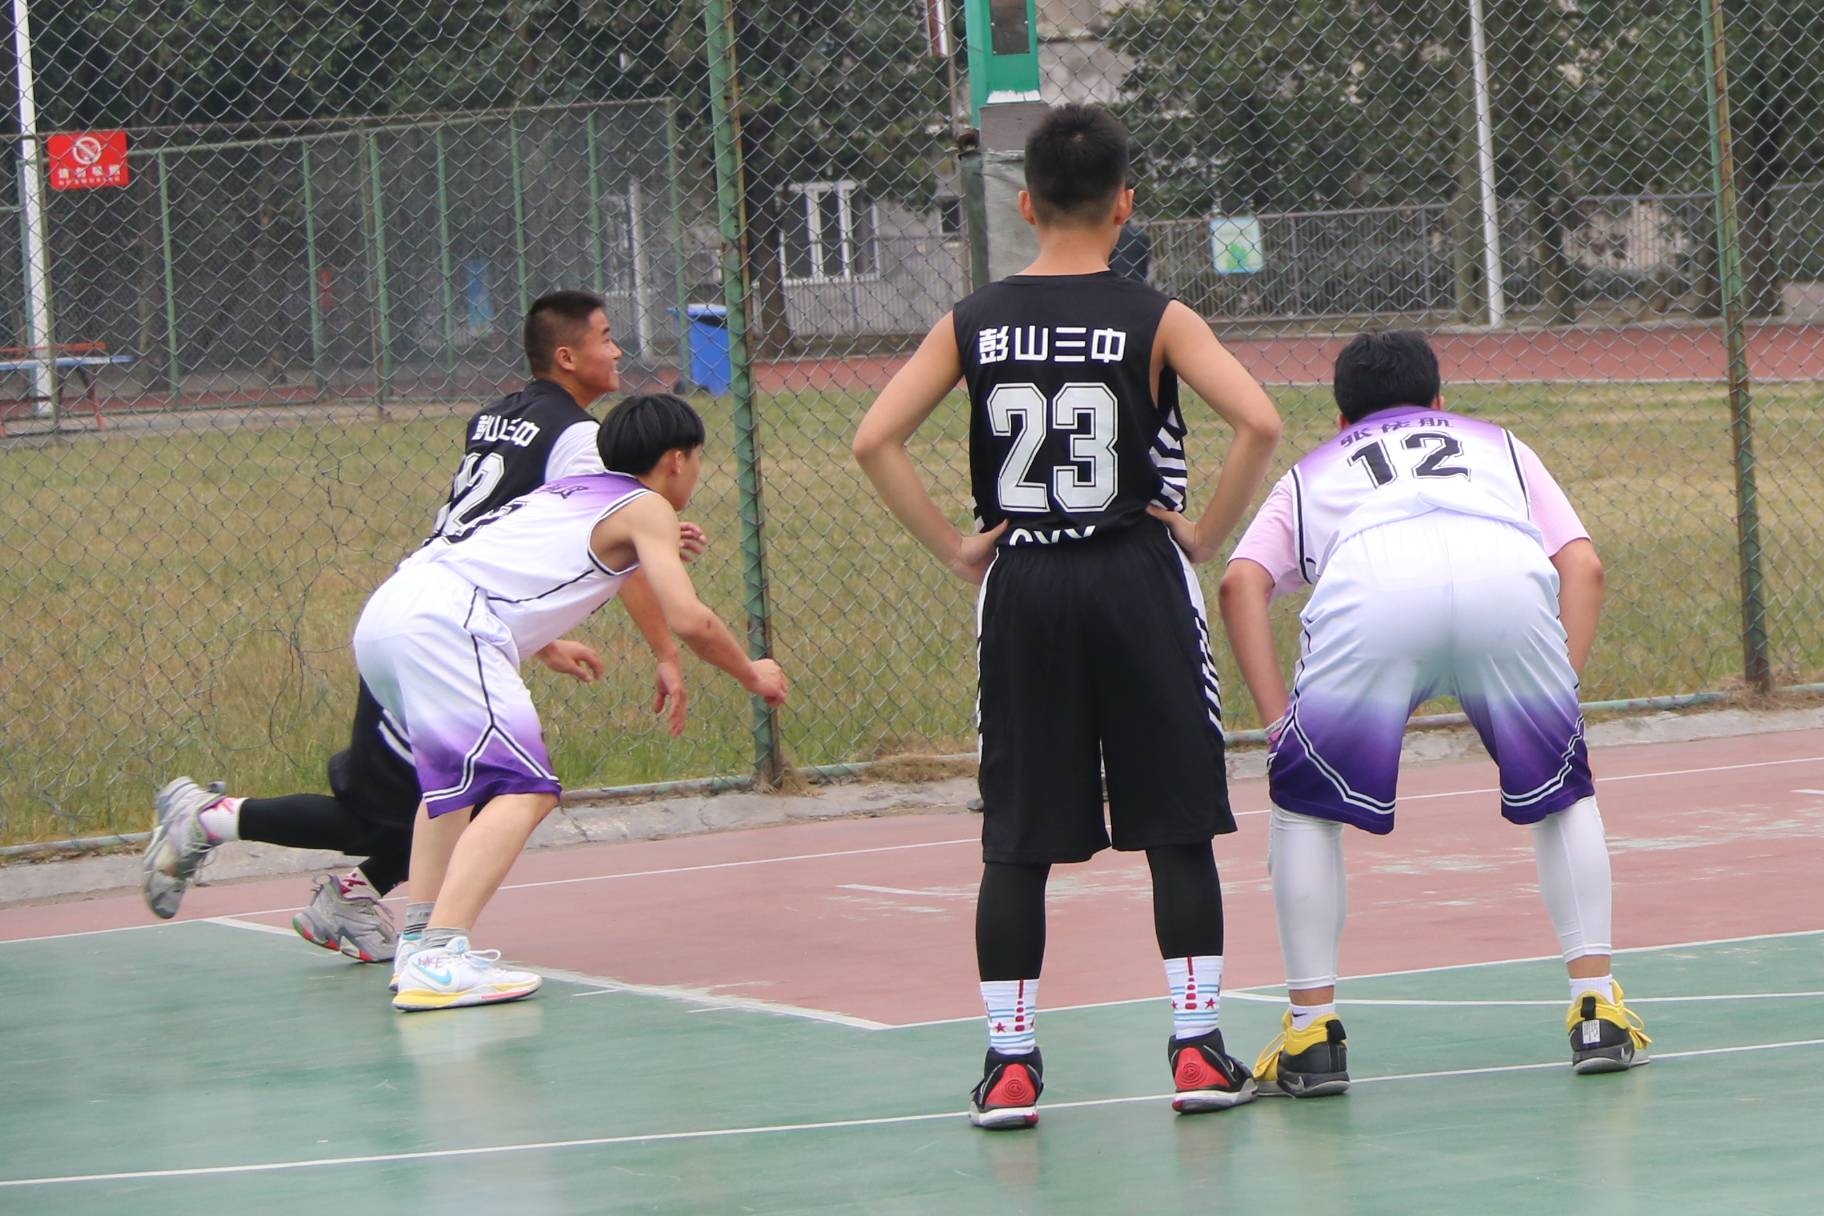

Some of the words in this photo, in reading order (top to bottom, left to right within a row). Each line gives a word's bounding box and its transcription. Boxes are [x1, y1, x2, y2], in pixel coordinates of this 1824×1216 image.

[979, 325, 1127, 364] 彭山三中
[987, 382, 1119, 513] 23
[1347, 430, 1472, 490] 12
